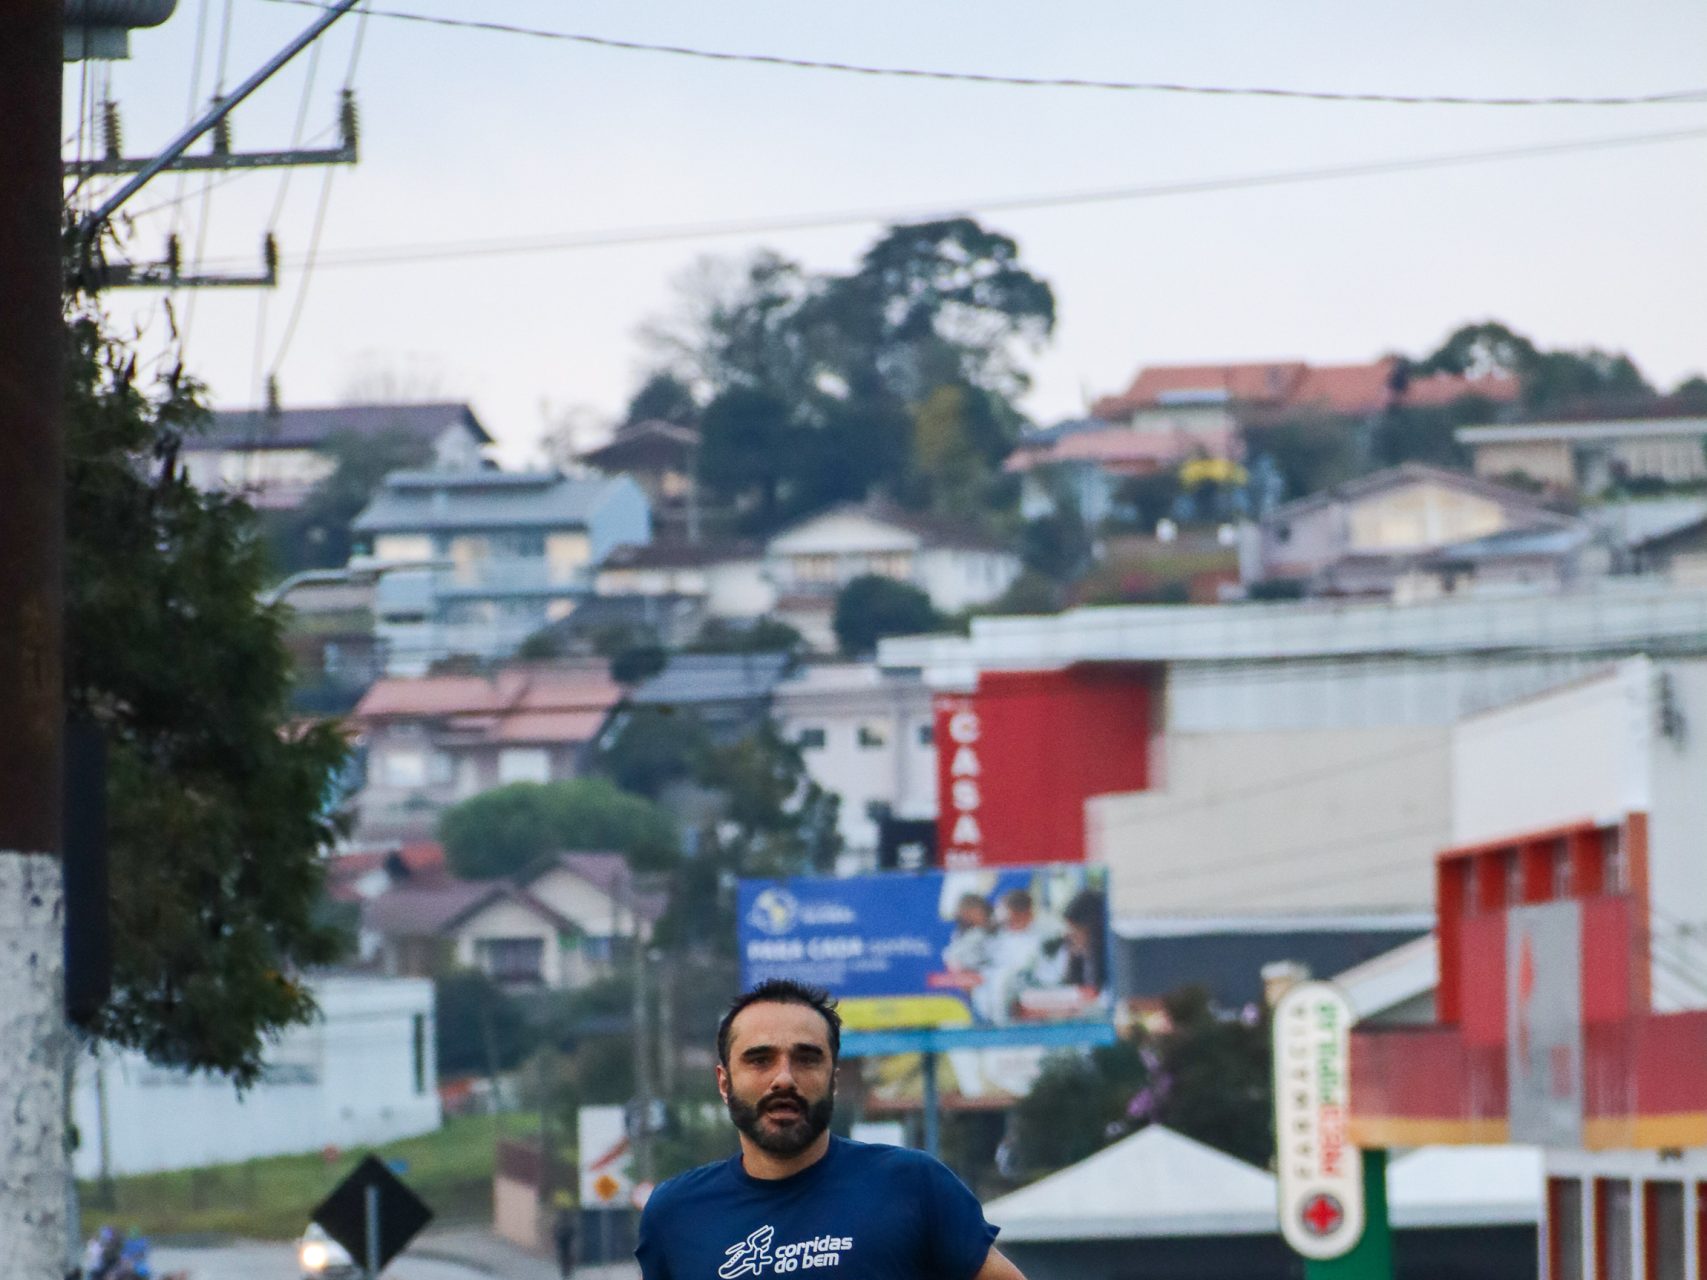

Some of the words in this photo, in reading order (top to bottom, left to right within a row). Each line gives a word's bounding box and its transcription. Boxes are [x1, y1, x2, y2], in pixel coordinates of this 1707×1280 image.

[950, 711, 982, 846] CASA
[775, 1235, 853, 1259] corridas
[774, 1256, 798, 1274] do
[802, 1252, 839, 1270] bem
